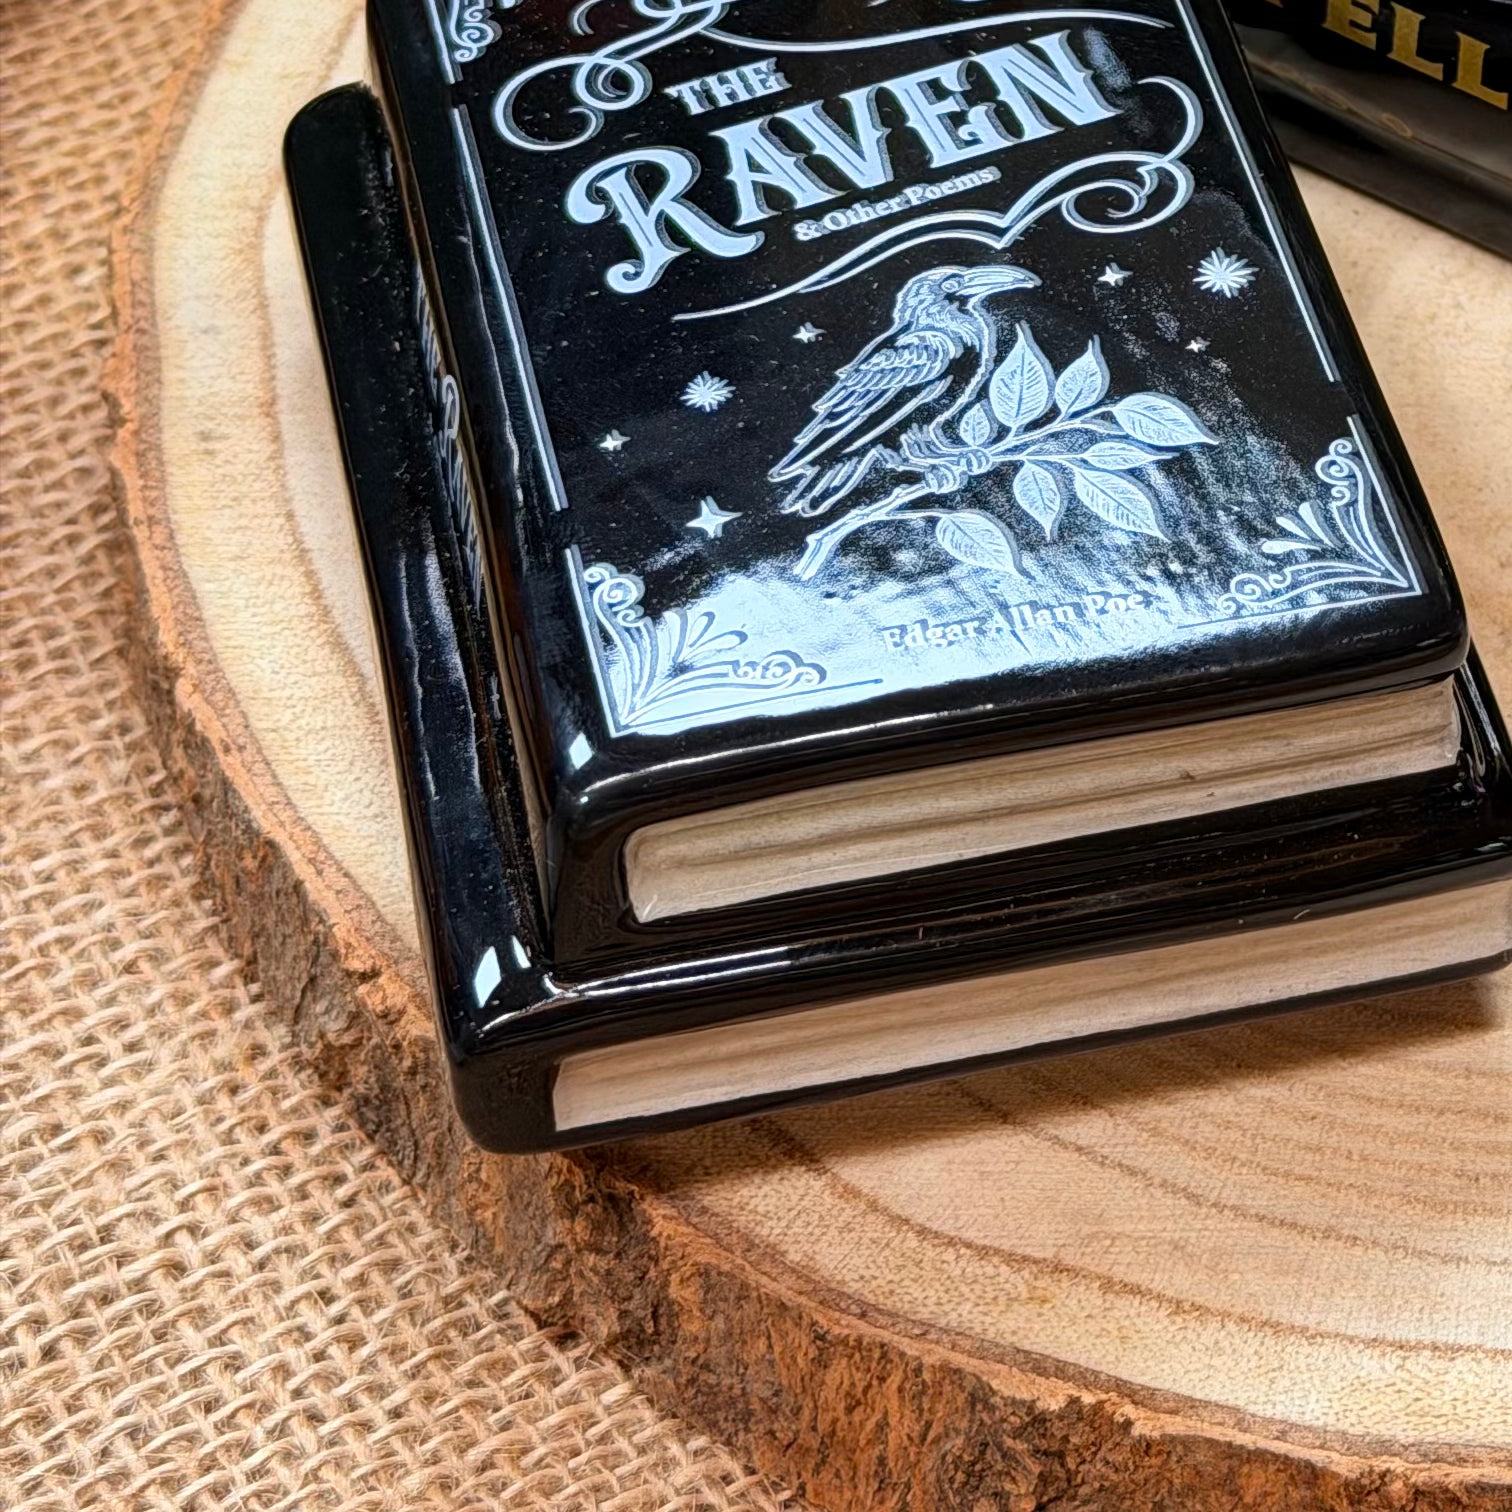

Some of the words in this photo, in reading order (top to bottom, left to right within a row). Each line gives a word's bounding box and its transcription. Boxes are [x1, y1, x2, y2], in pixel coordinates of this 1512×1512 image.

[664, 56, 792, 116] THE
[565, 28, 1125, 294] RAVEN
[821, 196, 905, 232] Other
[902, 165, 1002, 207] Poems
[881, 617, 981, 651] Edgar
[991, 600, 1077, 635] Allan
[1085, 590, 1147, 618] Poe
